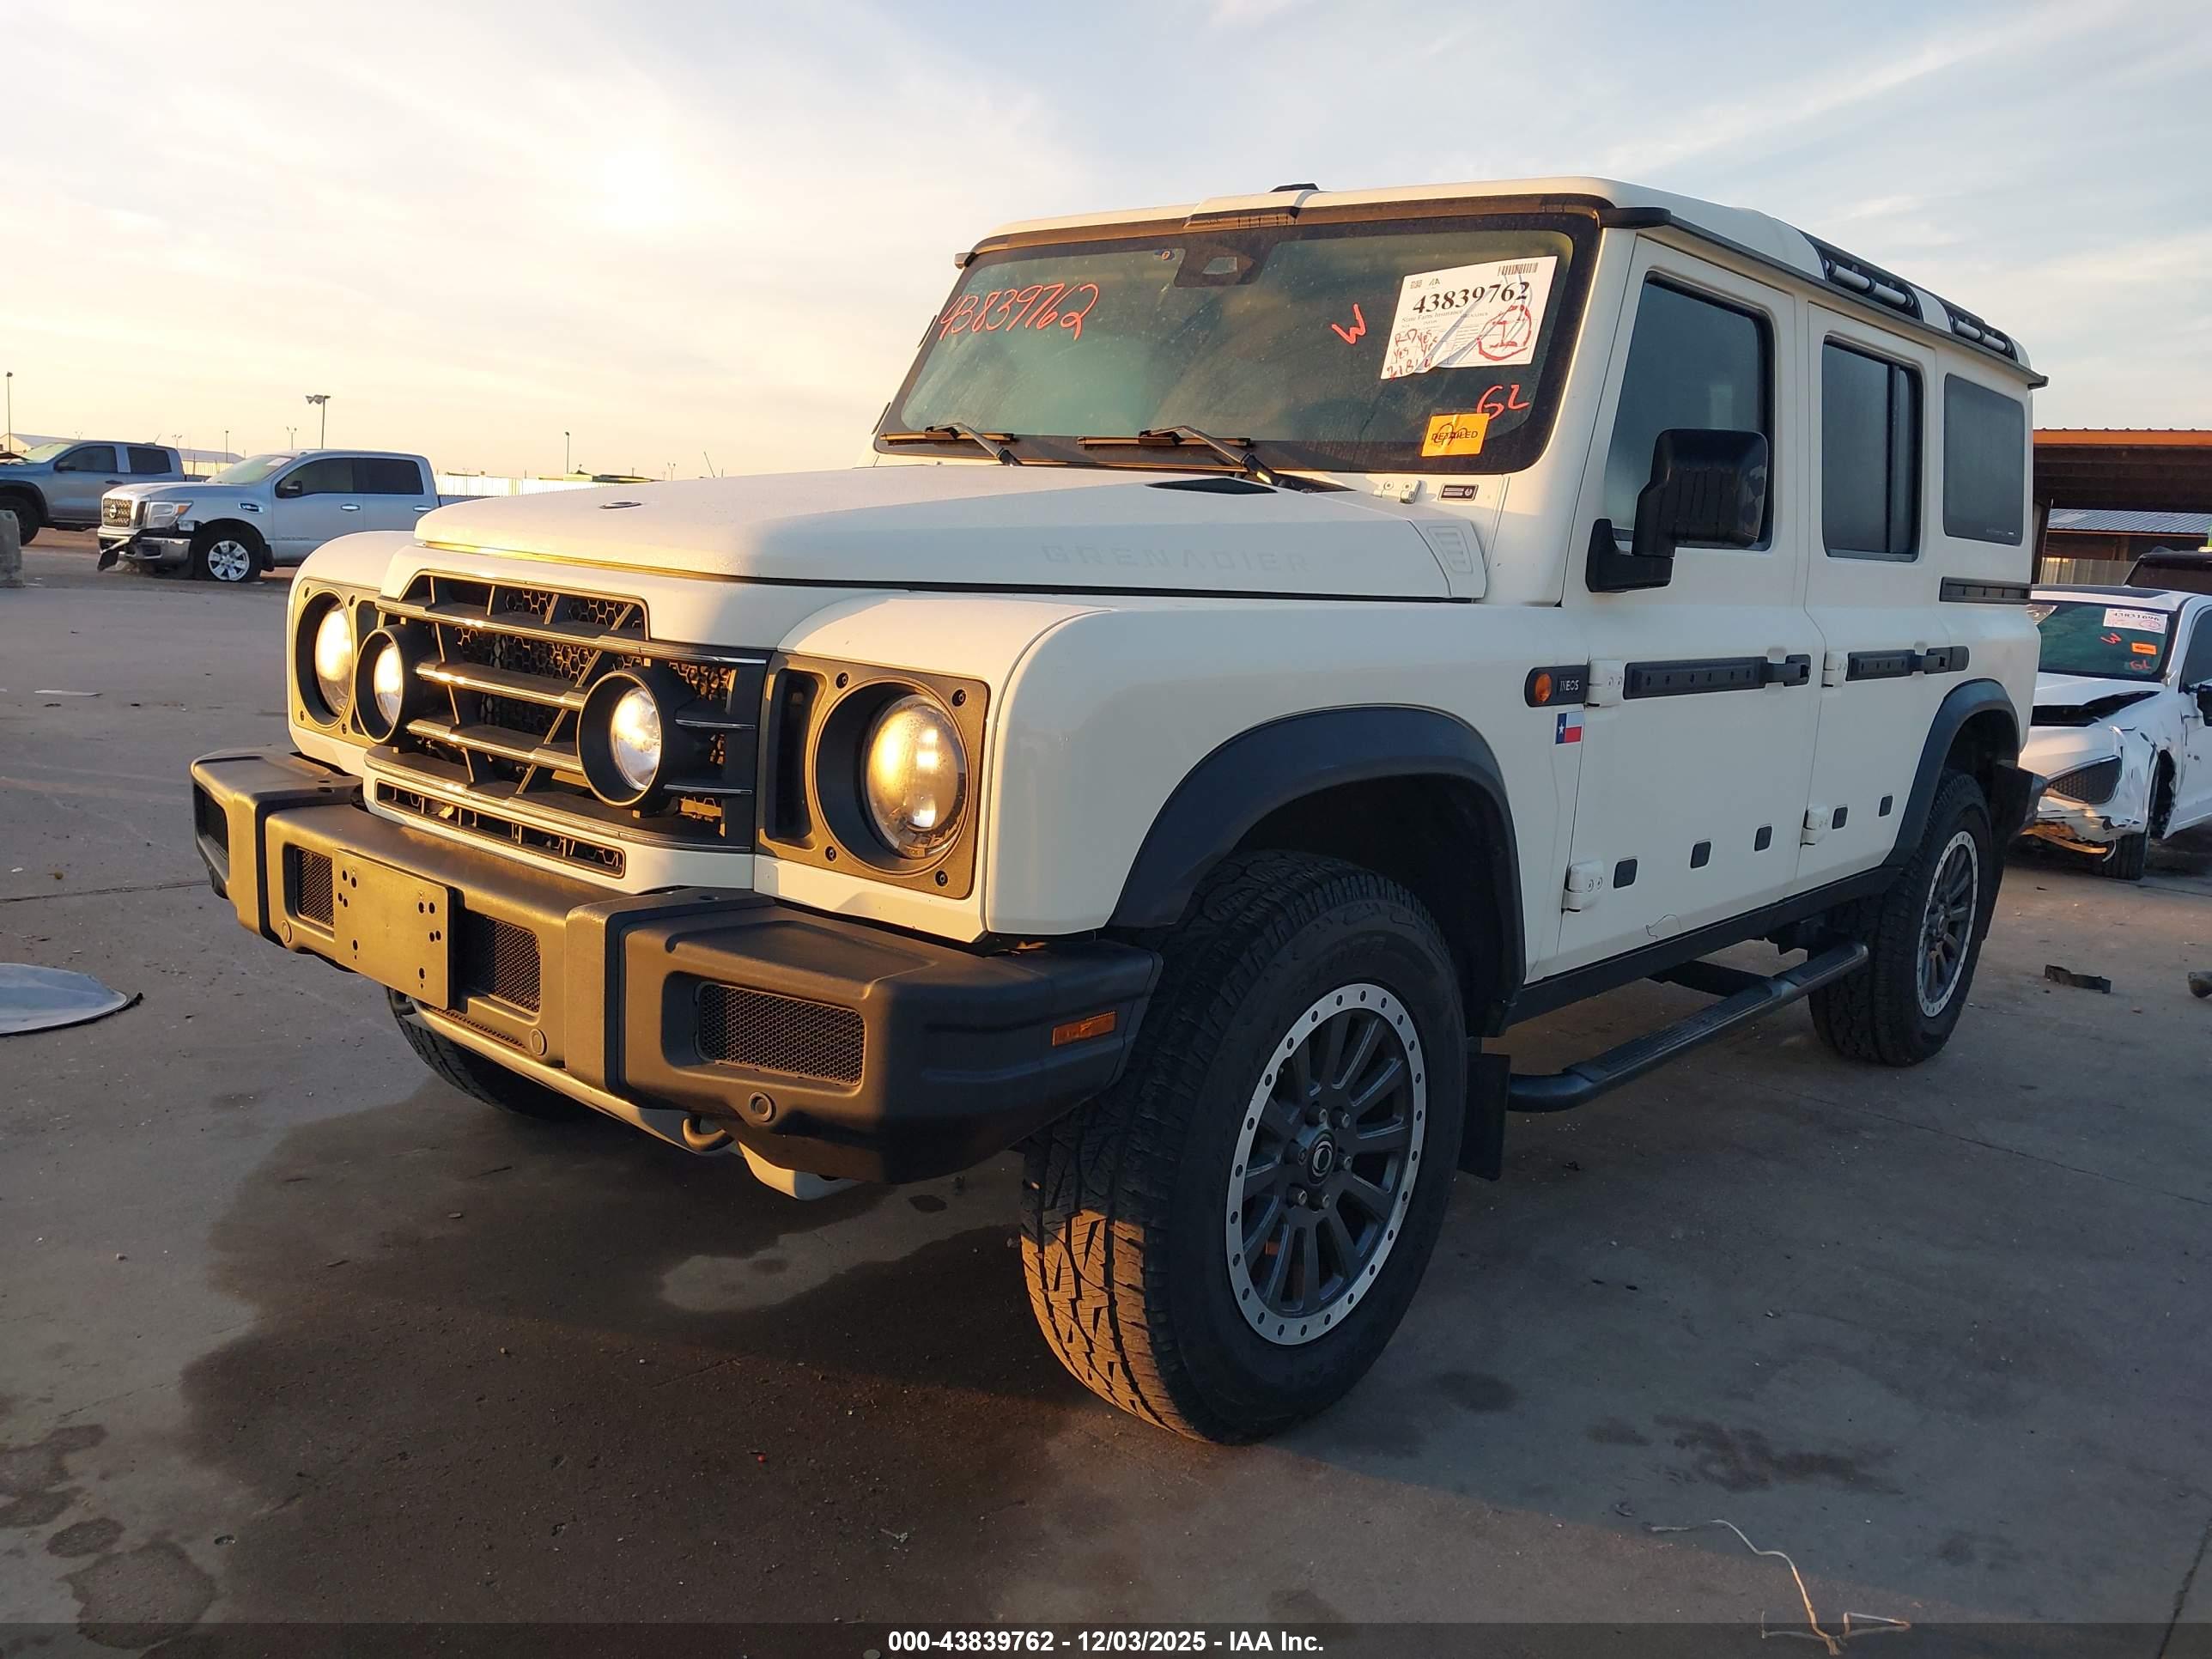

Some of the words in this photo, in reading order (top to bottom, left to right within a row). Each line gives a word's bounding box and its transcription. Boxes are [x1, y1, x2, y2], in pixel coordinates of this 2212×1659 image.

[939, 283, 1099, 341] 43839762
[1413, 282, 1530, 313] 43839762
[1332, 303, 1366, 344] W
[1040, 542, 1311, 574] GRENADIER
[1559, 679, 1580, 692] INEOS
